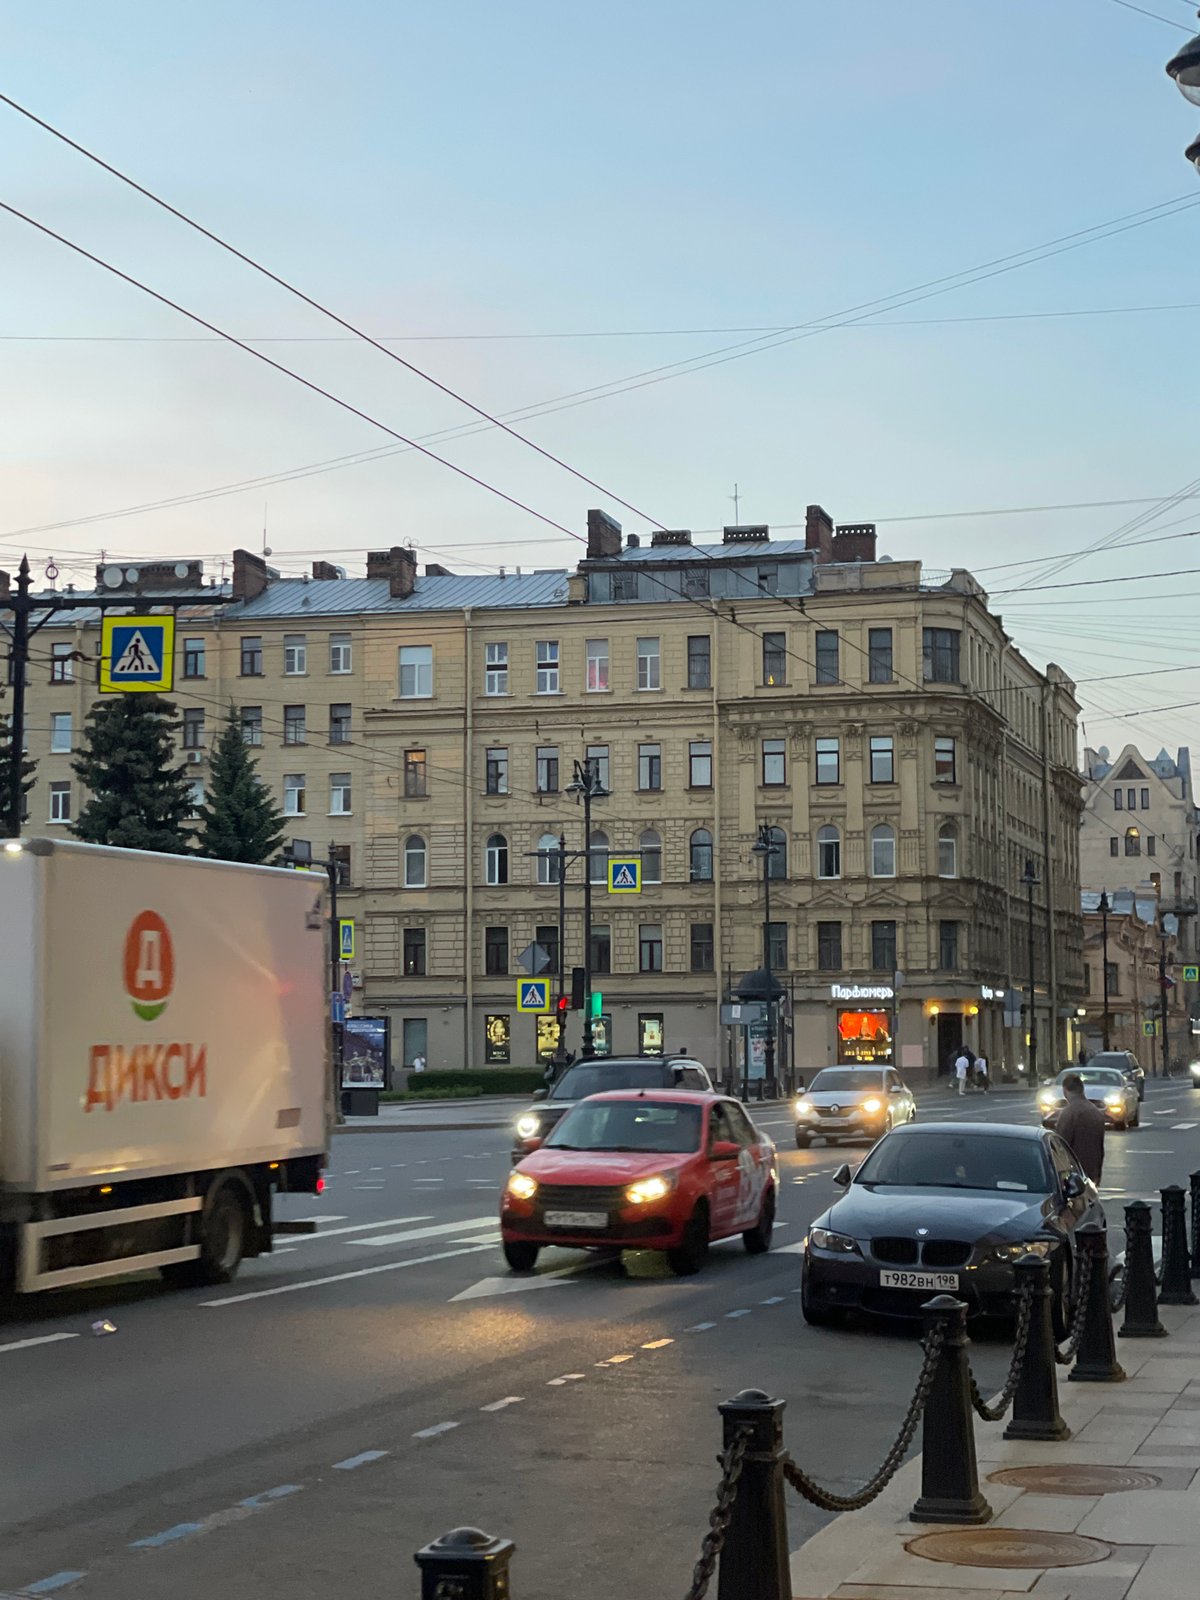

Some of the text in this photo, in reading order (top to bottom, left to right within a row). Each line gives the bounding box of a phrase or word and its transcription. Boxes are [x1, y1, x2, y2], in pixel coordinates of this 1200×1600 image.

[136, 930, 162, 989] Д
[84, 1043, 207, 1113] ДИКСИ
[936, 1275, 955, 1285] 198
